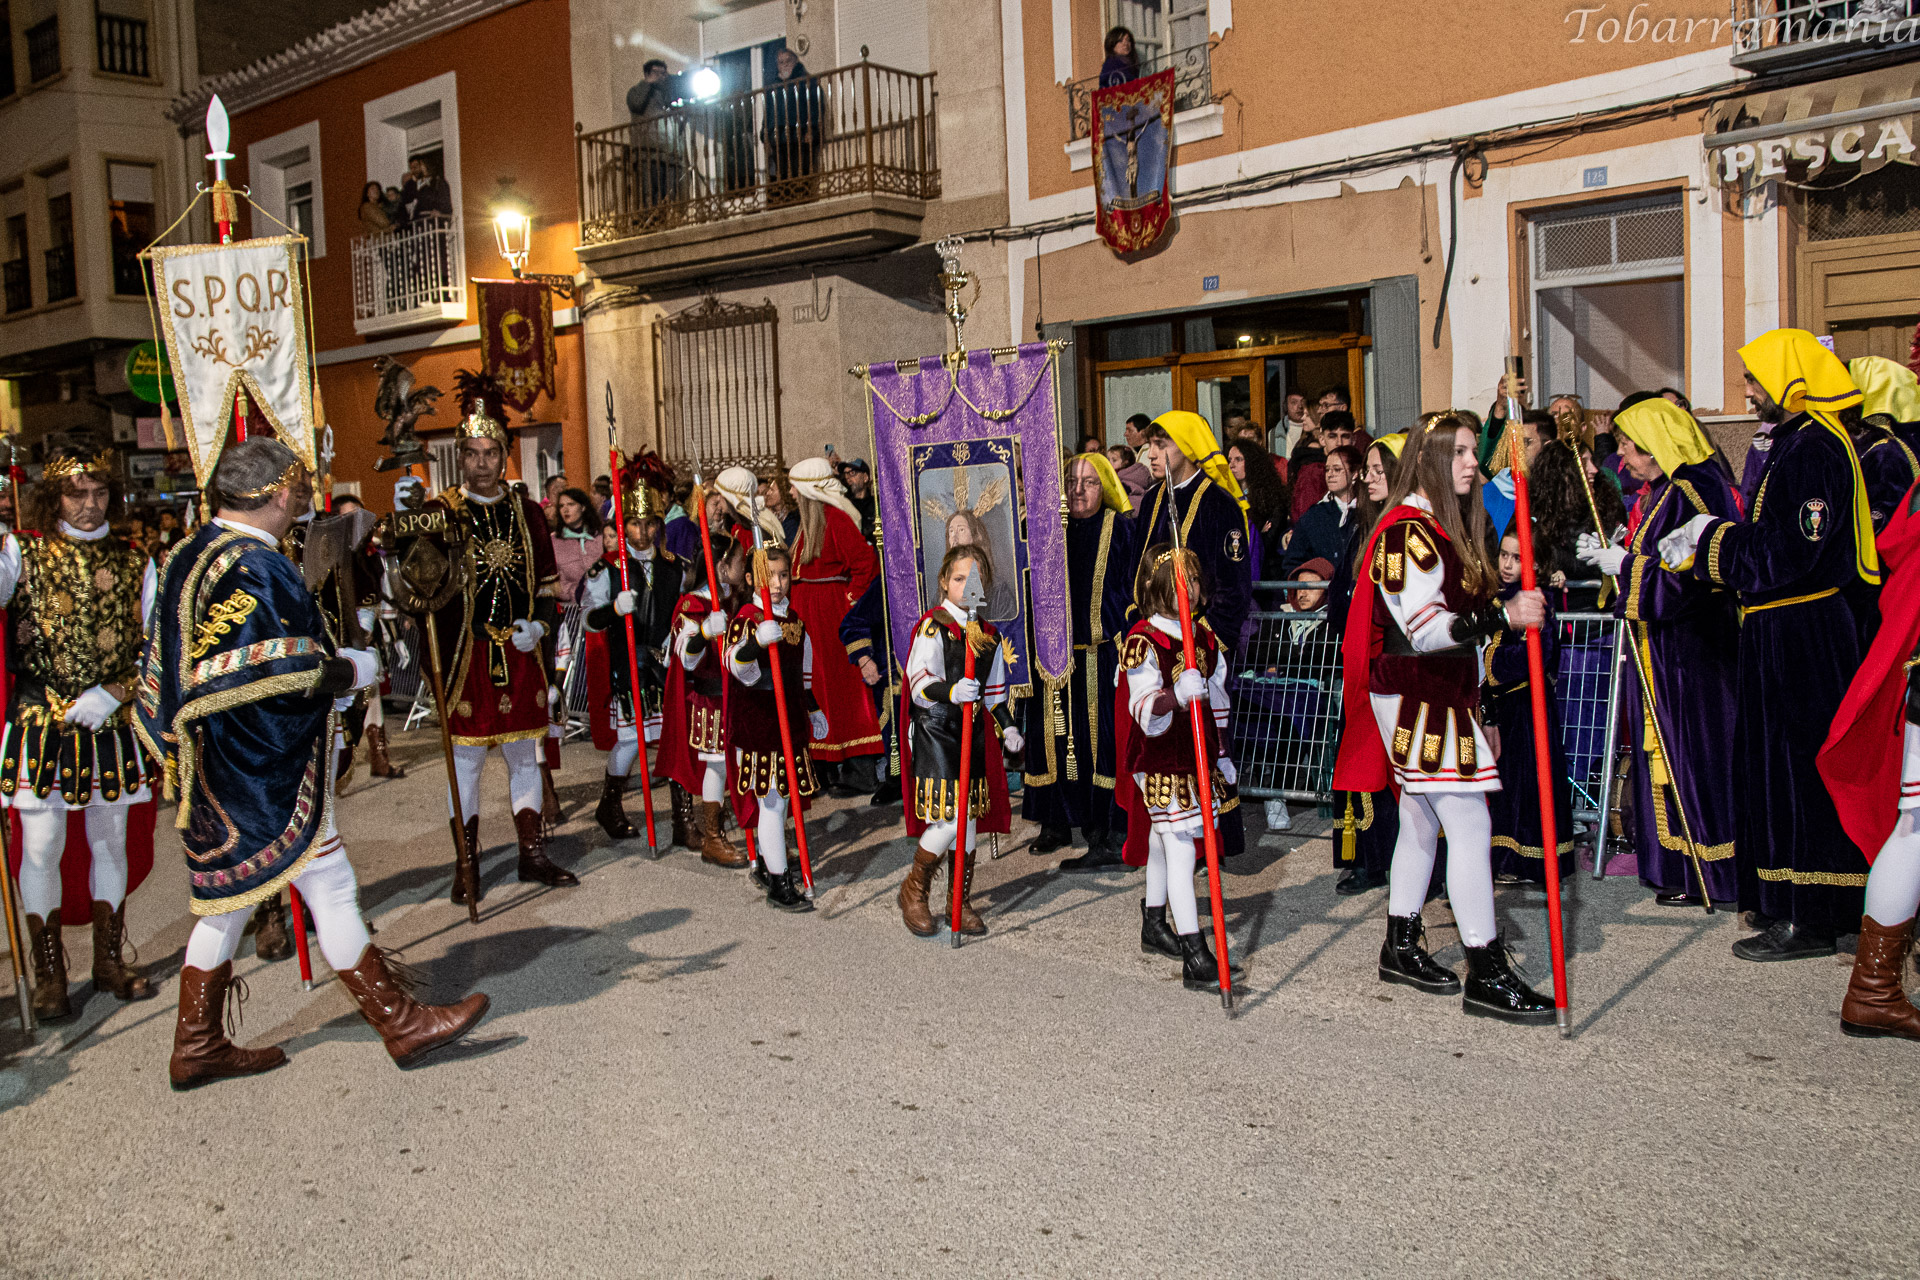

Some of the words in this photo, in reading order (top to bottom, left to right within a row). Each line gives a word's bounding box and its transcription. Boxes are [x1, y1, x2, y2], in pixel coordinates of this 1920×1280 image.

[1723, 118, 1916, 182] PESCA
[1586, 170, 1605, 185] 125
[1205, 278, 1218, 289] 123
[399, 511, 441, 533] SPQR
